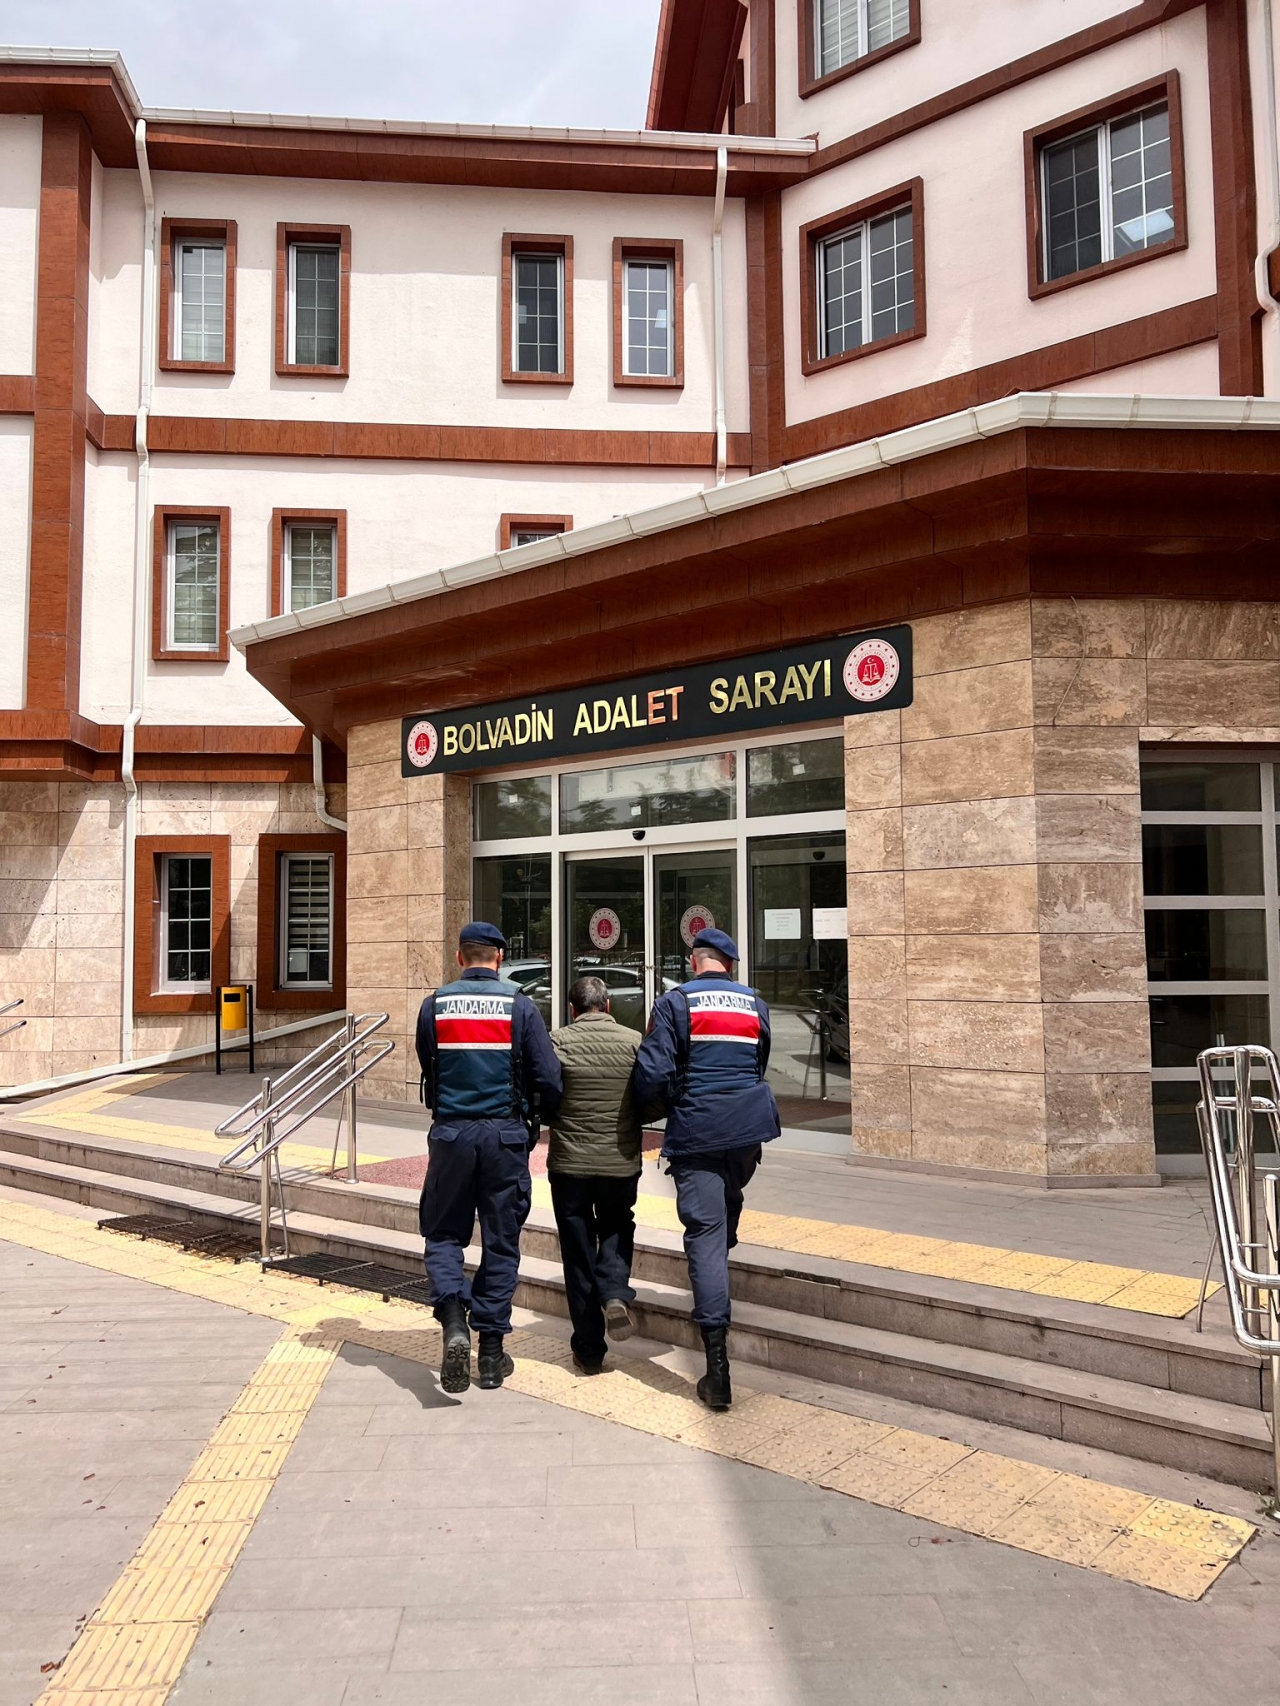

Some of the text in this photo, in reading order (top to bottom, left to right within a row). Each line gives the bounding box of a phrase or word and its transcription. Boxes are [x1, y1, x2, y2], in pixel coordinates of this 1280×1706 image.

[443, 703, 554, 756] BOLVADİN
[573, 686, 684, 736] ADALET
[709, 658, 832, 714] SARAYI
[442, 1000, 505, 1014] JANDARMA
[697, 994, 752, 1010] JANDARMA
